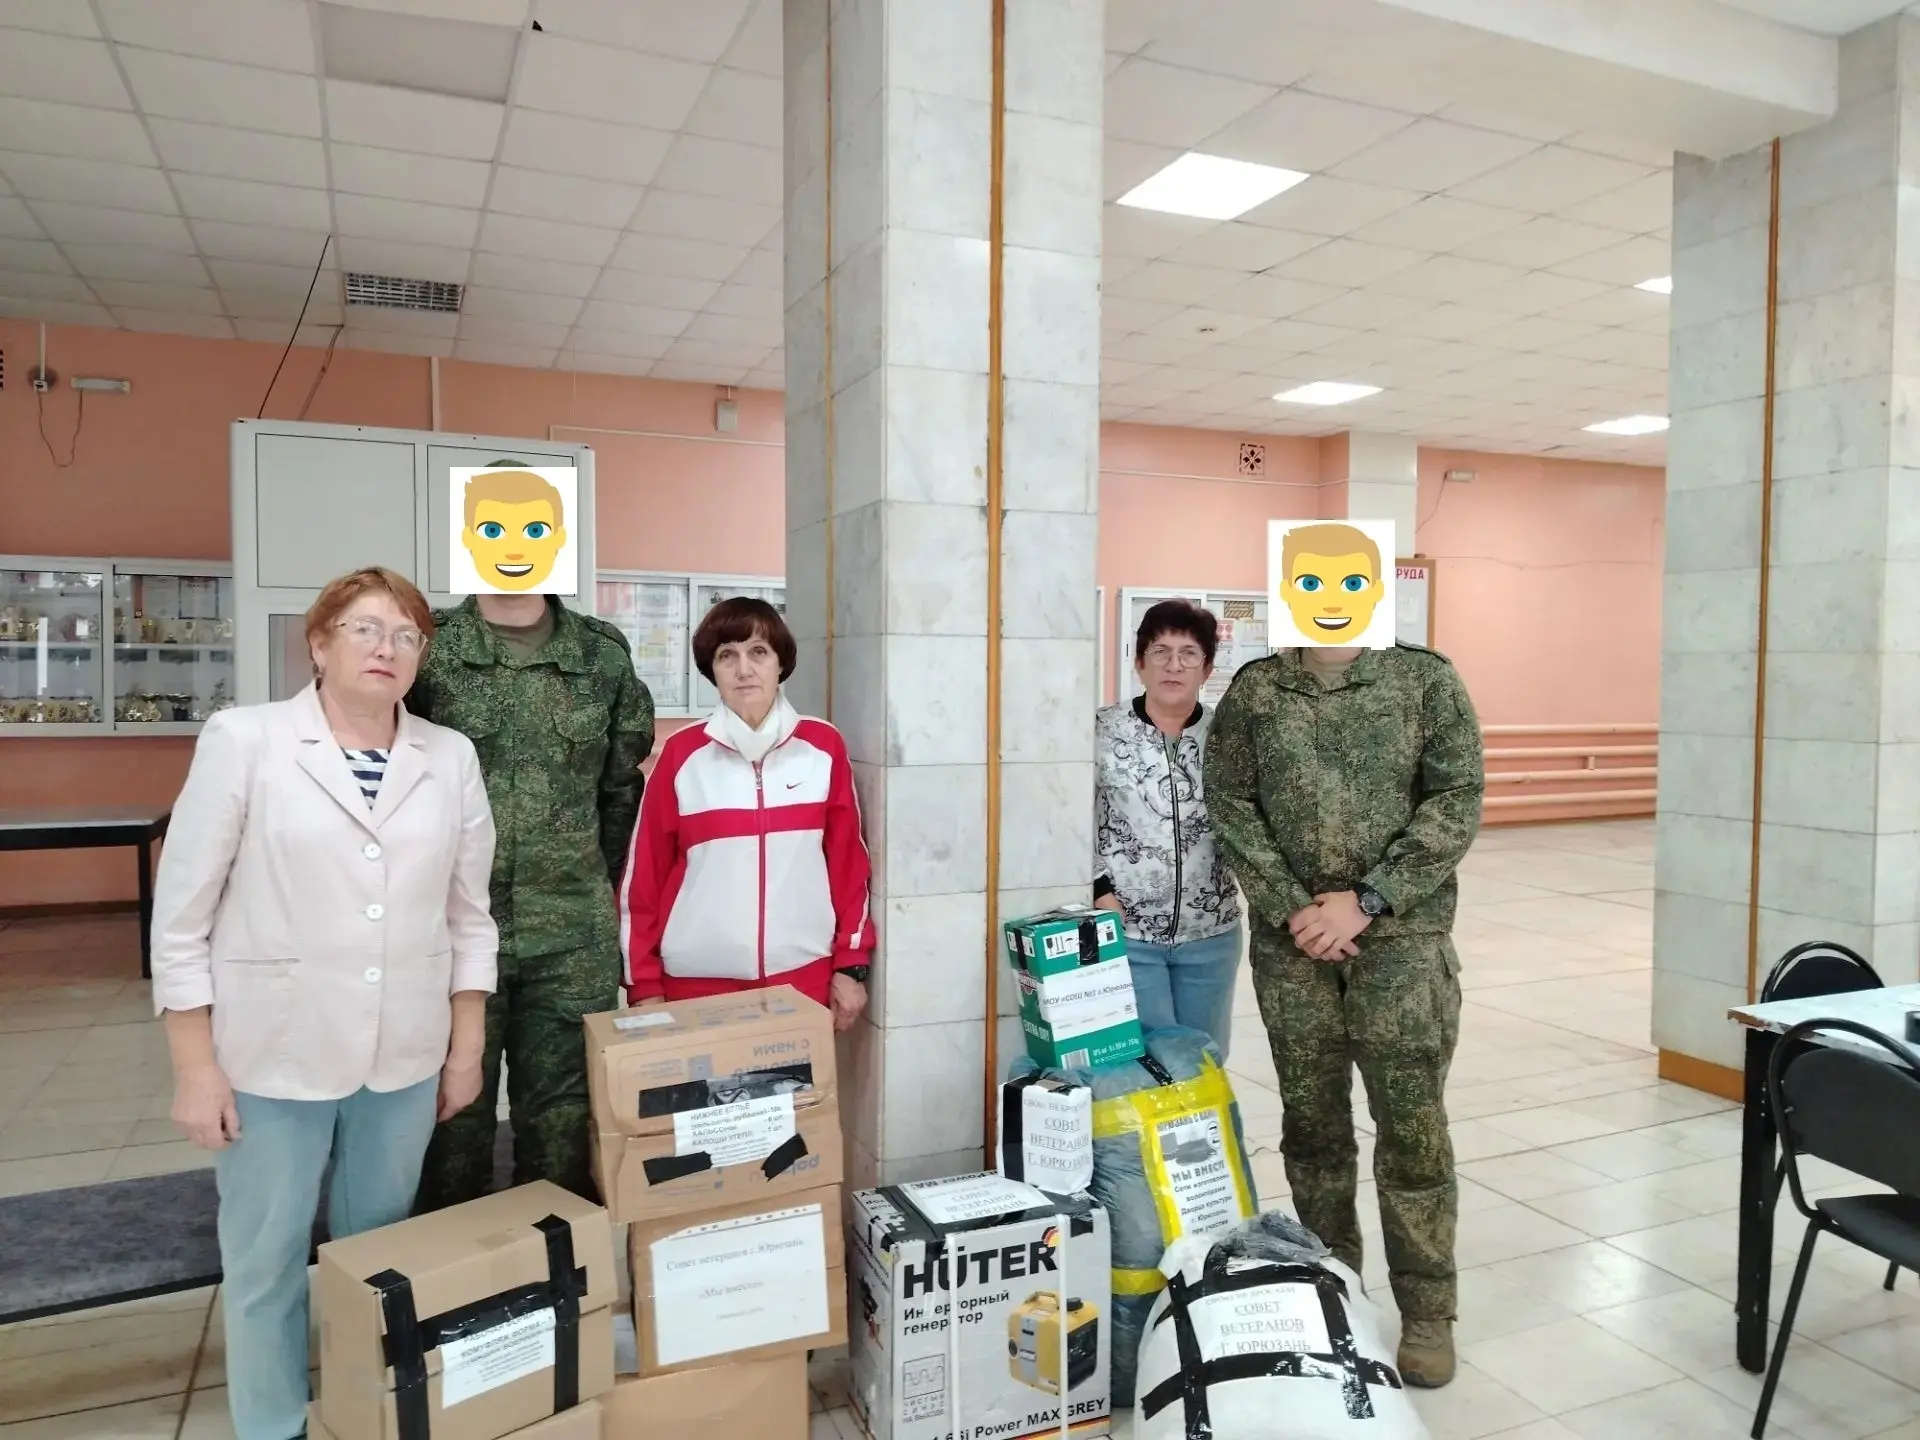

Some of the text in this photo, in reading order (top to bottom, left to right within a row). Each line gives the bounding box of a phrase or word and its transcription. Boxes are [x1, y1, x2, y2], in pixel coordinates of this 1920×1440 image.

[1396, 568, 1424, 579] РУДА
[1044, 1117, 1080, 1132] СОВЕТ
[1029, 1132, 1090, 1152] ВЕТЕРАНОВ
[1171, 1171, 1191, 1183] МЫ
[903, 1290, 1010, 1321] Инерорный
[1234, 1300, 1281, 1316] СОВЕТ
[903, 1312, 984, 1337] генертор
[1220, 1318, 1305, 1337] ВЕТЕРАНОВ
[1237, 1339, 1312, 1354] ЮРЮЗАНЬ
[974, 1416, 1022, 1437] Power
[1026, 1406, 1062, 1427] MAX
